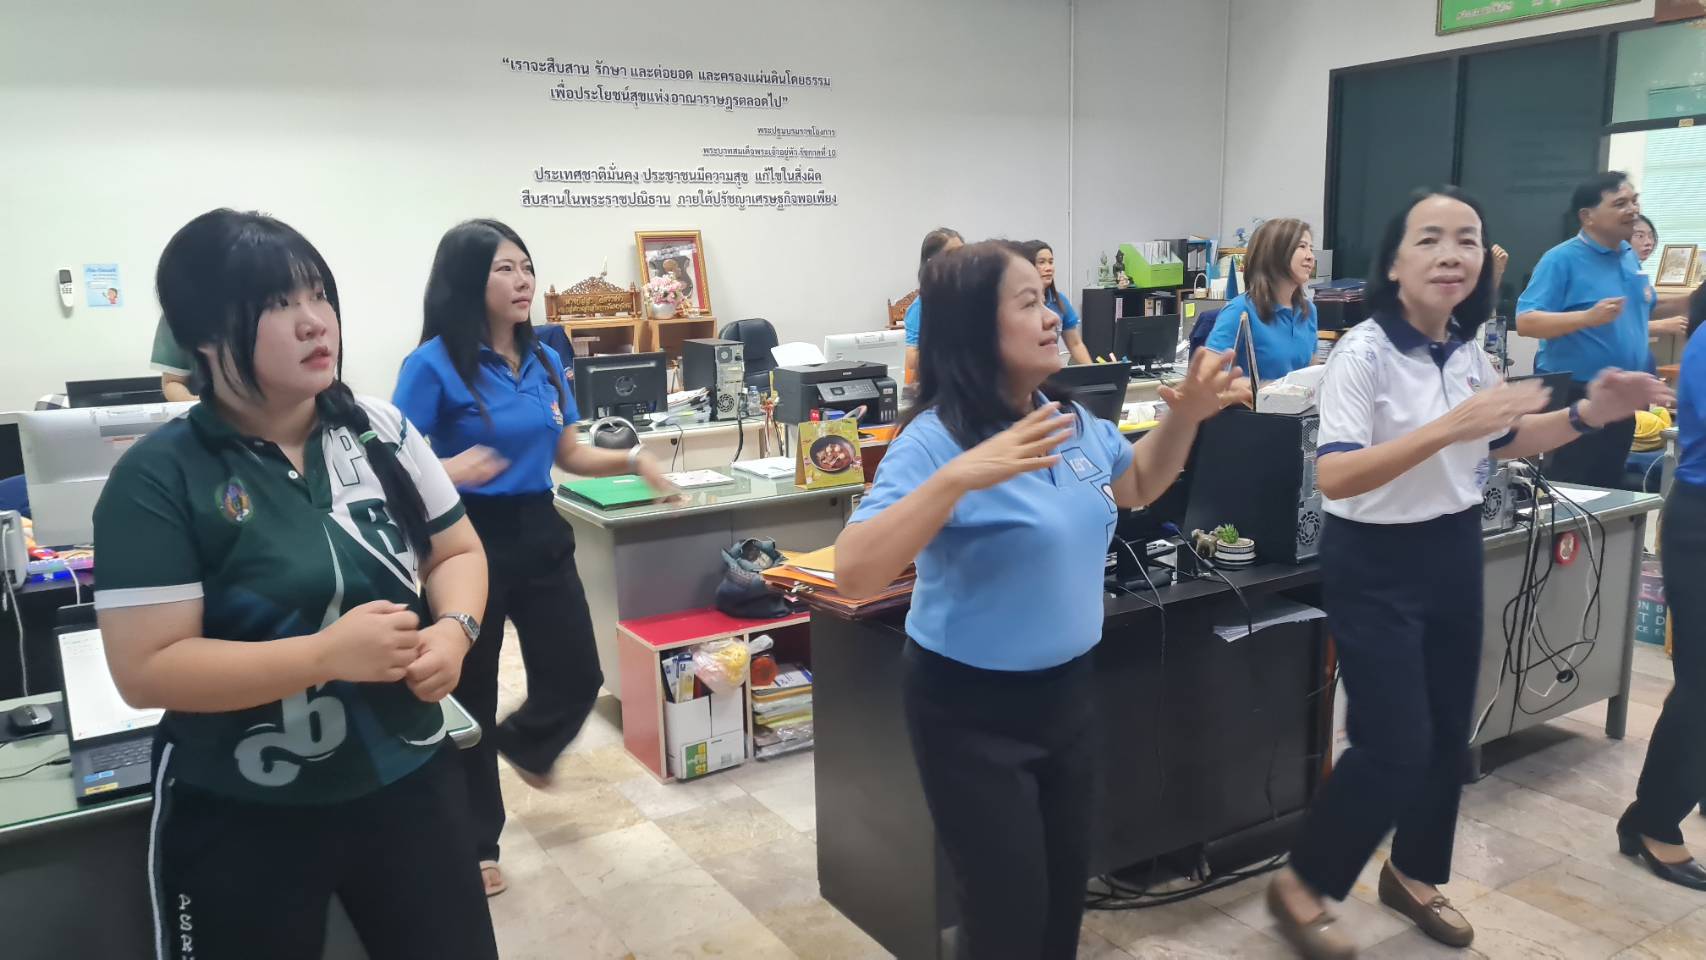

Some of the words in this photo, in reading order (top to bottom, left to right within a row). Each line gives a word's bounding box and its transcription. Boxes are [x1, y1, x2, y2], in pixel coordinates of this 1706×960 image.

[594, 59, 627, 76] รักษา
[630, 64, 693, 79] และต่อยอด
[698, 69, 831, 86] และครองแผ่นดินโดยธรรม
[535, 163, 639, 181] ประเทศชาติมั่นคง
[643, 167, 748, 185] ประชาชนมีความสุข
[755, 165, 822, 181] แก้ไขในสิ่งผิด
[522, 189, 671, 205] สืบสานในพระราชปณิธาน
[678, 190, 837, 208] ภายใต้ปรัชญาเศรษฐกิจพอเพียง
[178, 893, 195, 960] PSR
